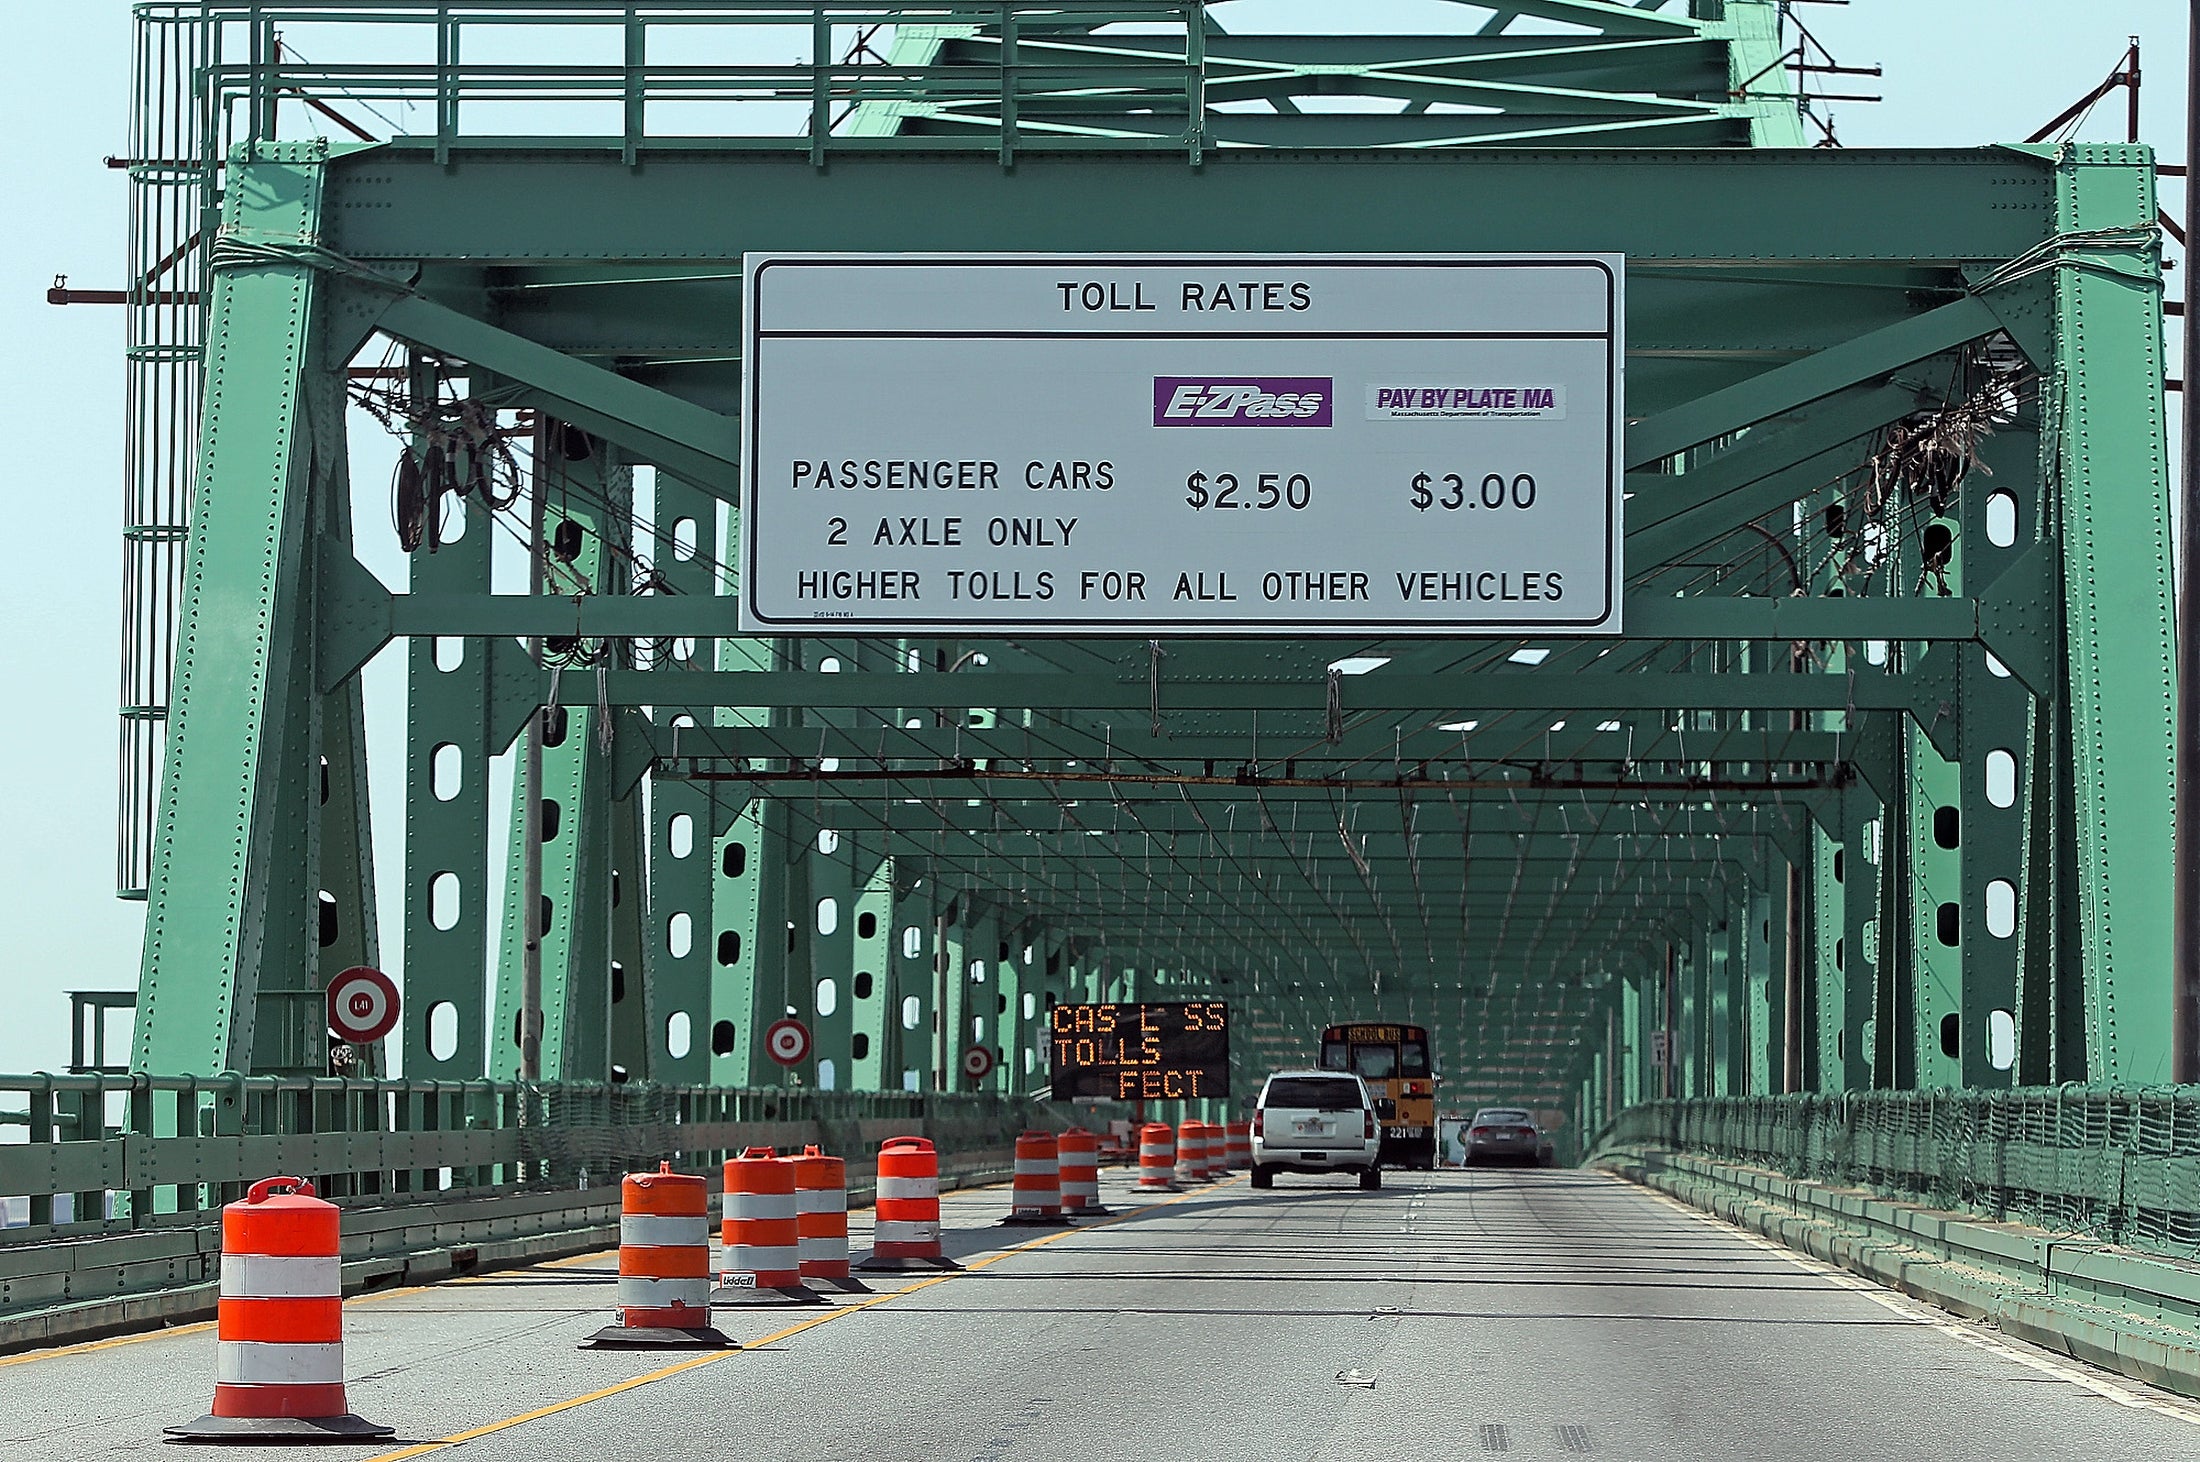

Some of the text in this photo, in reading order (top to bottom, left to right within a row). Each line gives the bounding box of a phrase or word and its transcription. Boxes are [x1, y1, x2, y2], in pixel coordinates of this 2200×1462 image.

[1056, 282, 1311, 311] TOLL RATES
[1163, 385, 1324, 418] E-ZPass
[1377, 388, 1555, 409] PAY BY PLATE MA
[792, 460, 1114, 490] PASSENGER CARS
[1185, 470, 1311, 512] $2.50
[1409, 471, 1536, 513] $3.00
[827, 517, 1078, 547] 2 AXLE ONLY
[798, 570, 1563, 601] HIGHER TOLLS FOR ALL OTHER VEHICLES
[1054, 1037, 1162, 1067] TOLLS
